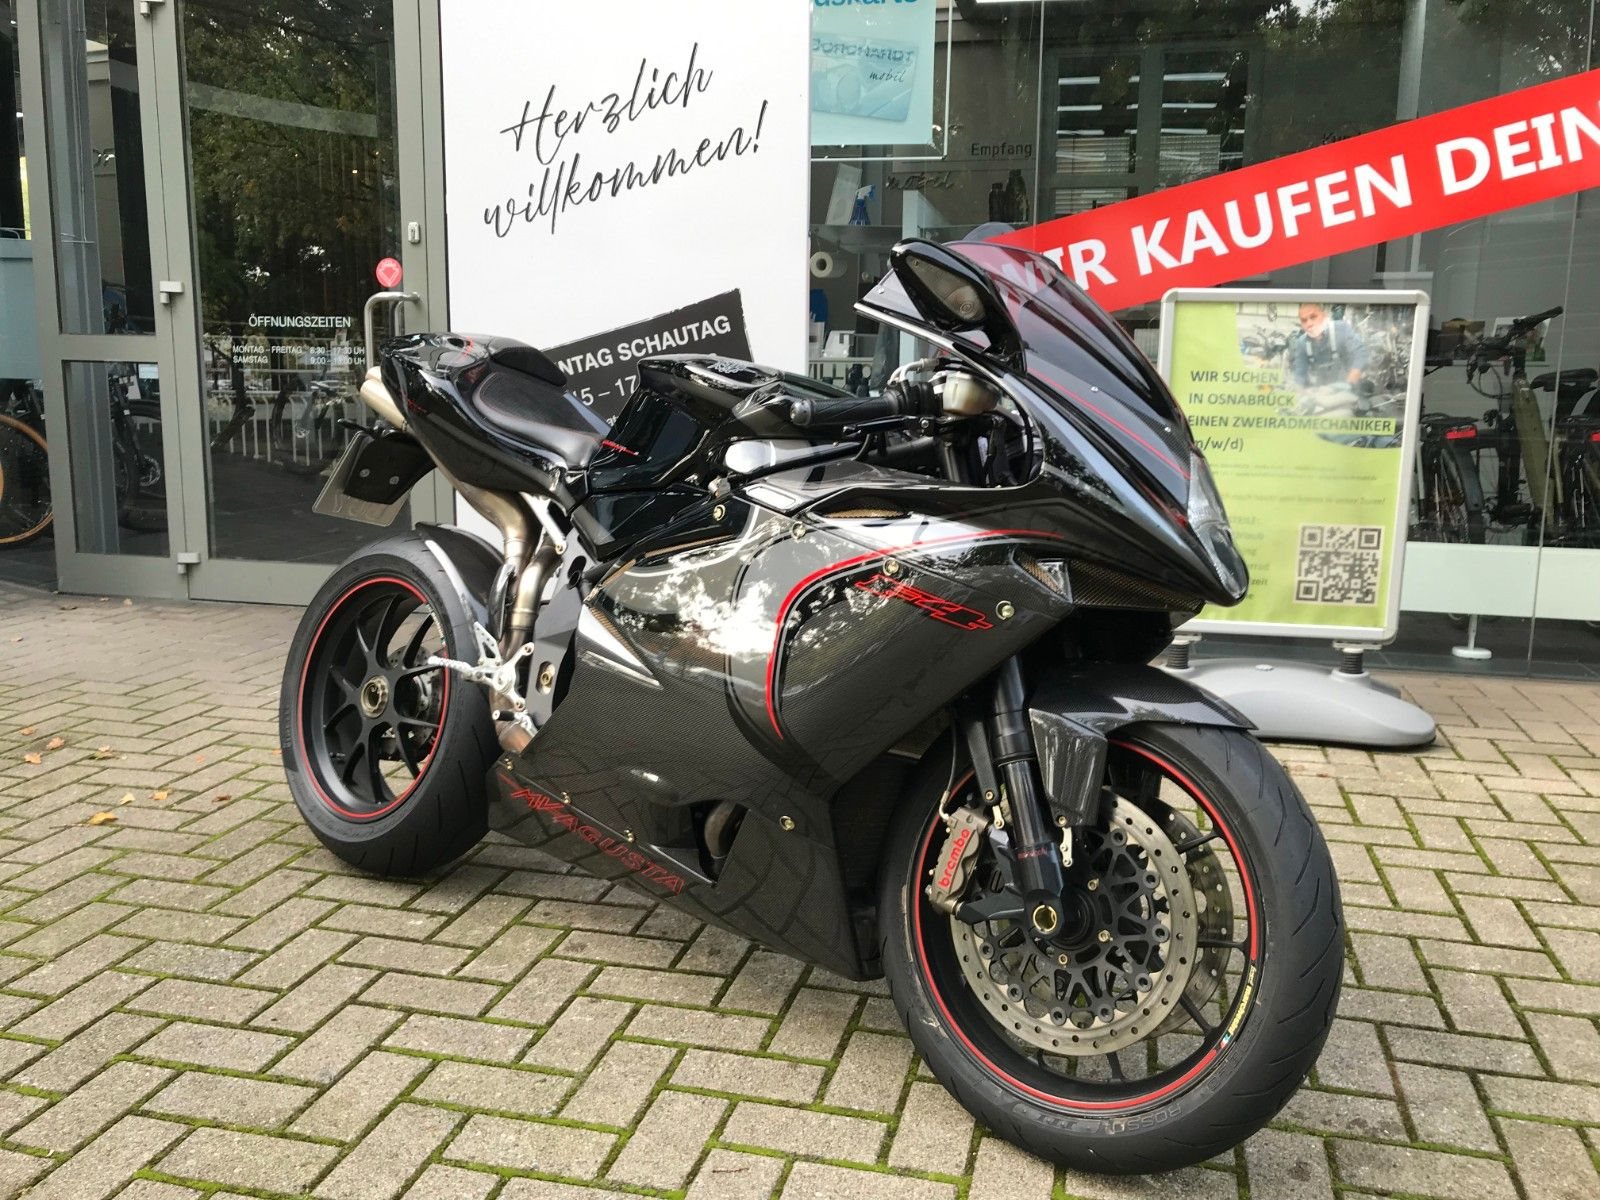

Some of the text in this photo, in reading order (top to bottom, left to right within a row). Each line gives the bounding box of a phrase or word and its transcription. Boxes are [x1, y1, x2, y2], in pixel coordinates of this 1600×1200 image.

[500, 42, 713, 166] Herzlich
[971, 143, 1033, 158] Empfang
[484, 100, 768, 238] willkommen!
[1130, 154, 1413, 276] KAUFEN
[248, 314, 351, 328] ÖFFNUNGSZEITEN
[617, 315, 732, 361] SCHAUTAG
[232, 345, 265, 354] MONTAG
[271, 345, 303, 354] FREITAG
[353, 346, 366, 355] UH
[232, 355, 269, 364] SAMSTAG
[353, 357, 366, 365] UH
[1191, 371, 1279, 384] WIR SUCHEN
[1189, 391, 1295, 407] IN OSNABRÜCK
[1188, 415, 1392, 432] EINEN ZWEIRADMECHANIKER
[553, 814, 686, 896] AGUSTA
[938, 828, 970, 887] brembo
